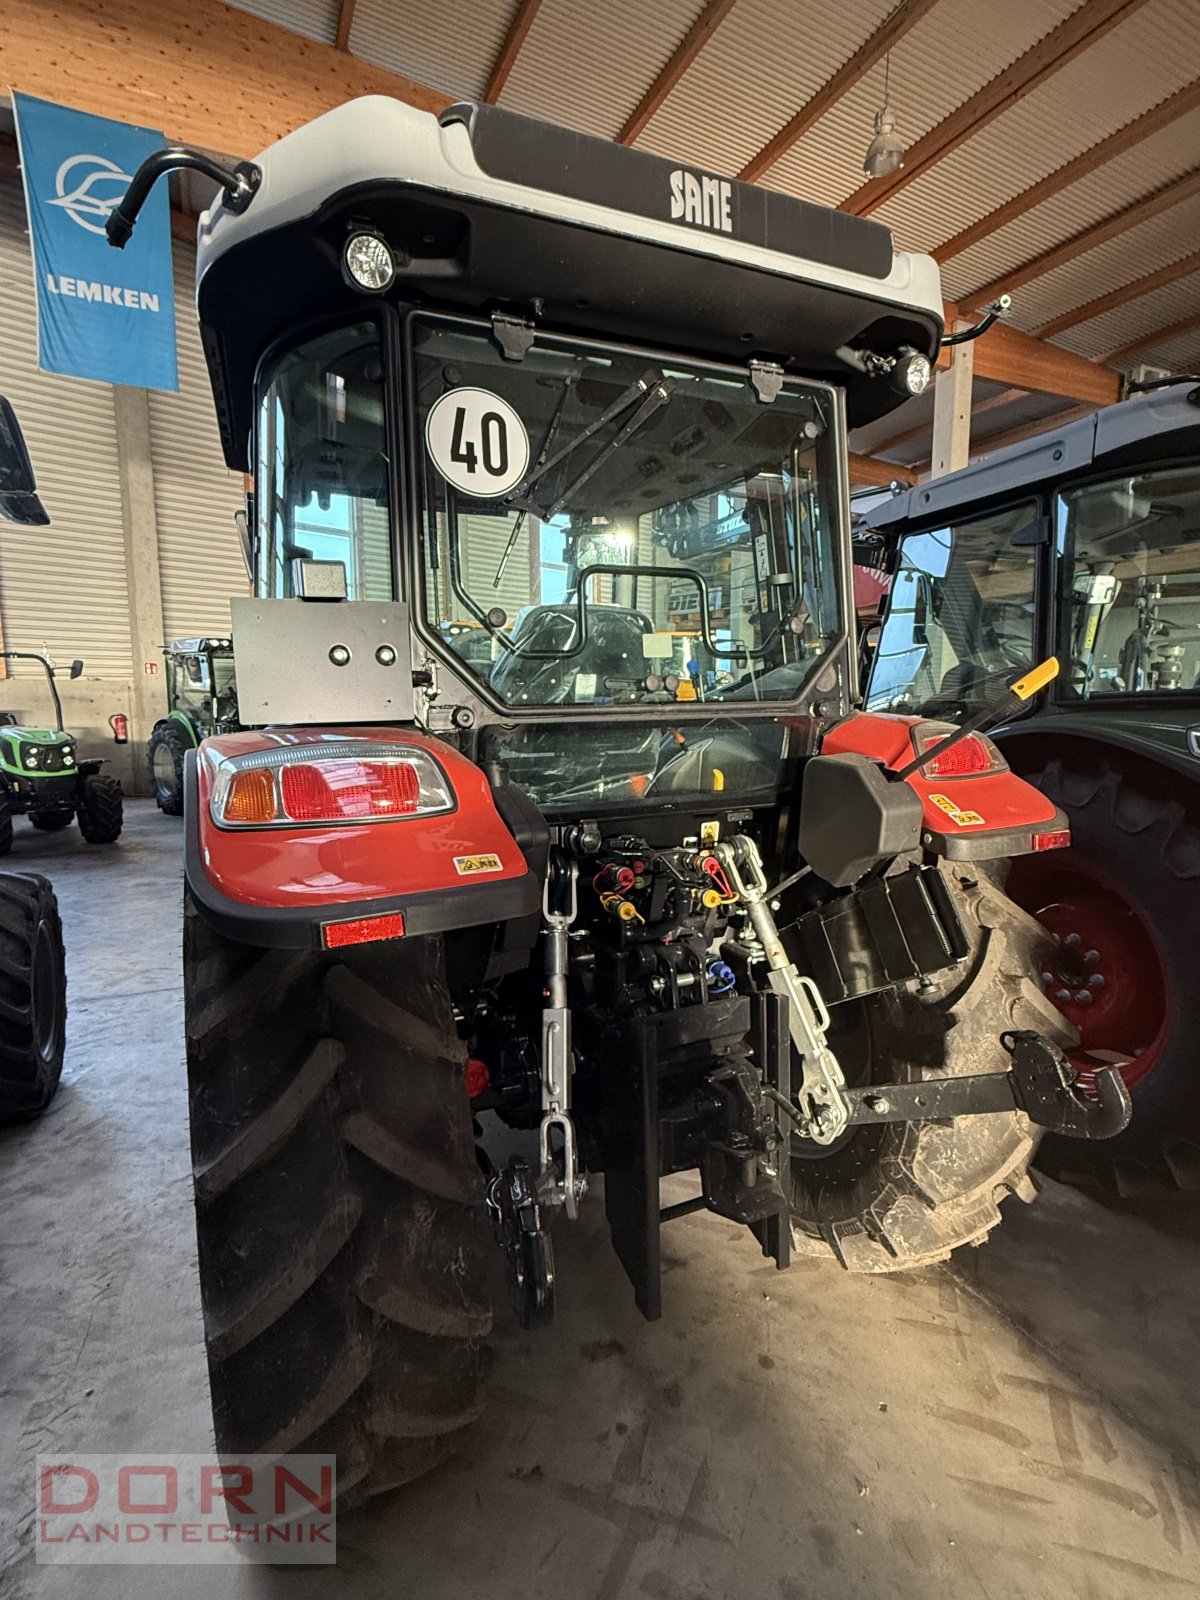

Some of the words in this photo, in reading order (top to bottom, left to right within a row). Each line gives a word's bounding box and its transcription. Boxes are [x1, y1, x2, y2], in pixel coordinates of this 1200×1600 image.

[669, 170, 733, 233] SAME
[46, 272, 160, 313] LEMKEN
[450, 406, 509, 477] 40
